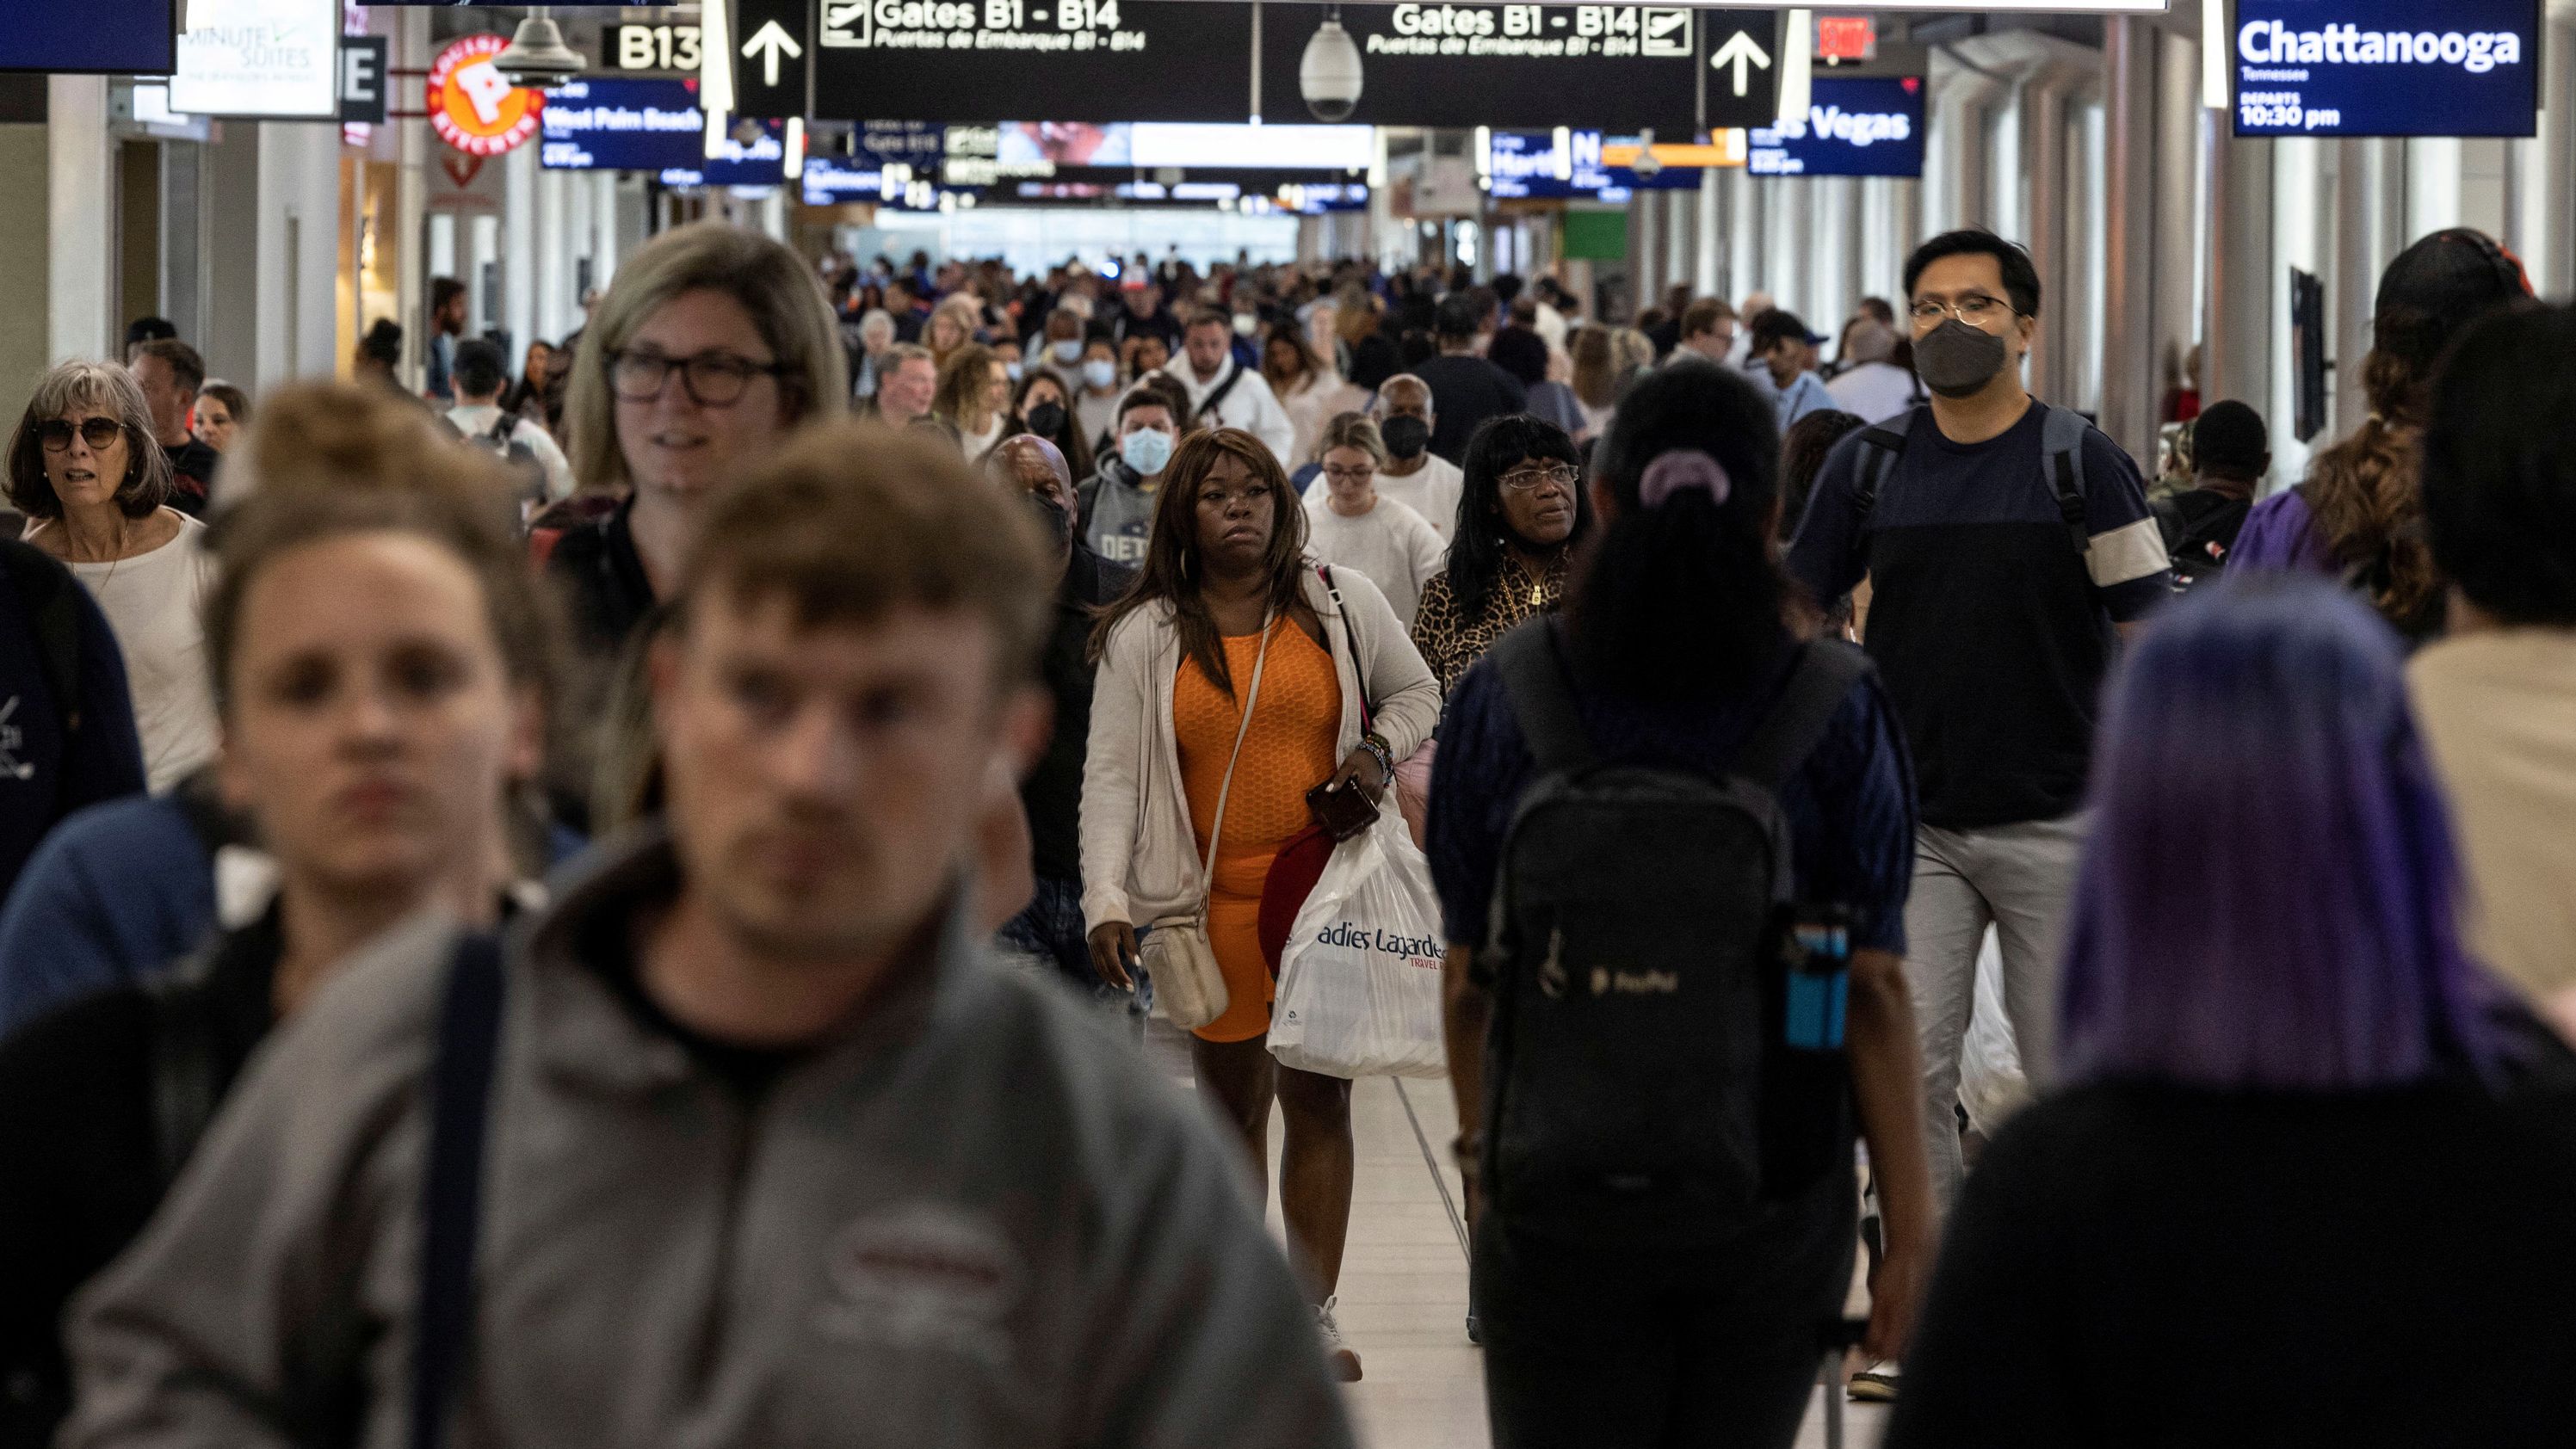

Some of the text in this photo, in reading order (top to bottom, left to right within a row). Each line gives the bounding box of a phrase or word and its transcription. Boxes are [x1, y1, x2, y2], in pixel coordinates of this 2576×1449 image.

[874, 0, 1121, 31] Gates B1 - B14
[1393, 3, 1639, 36] Gates B1 - B14
[619, 25, 701, 71] B13
[874, 28, 946, 48] Puertas
[948, 29, 974, 49] de
[975, 28, 1072, 52] Embarque
[1072, 30, 1096, 51] B1
[1109, 31, 1146, 51] B14
[1367, 34, 1438, 54] Puertas
[1440, 35, 1467, 55] de
[1467, 35, 1565, 58] Embarque
[1565, 36, 1590, 57] B1
[1603, 36, 1638, 57] B14
[2239, 20, 2521, 73] Chattanooga
[239, 46, 312, 68] SUITES
[429, 36, 503, 86] LOUISI
[2239, 66, 2310, 82] Tennessee
[2239, 91, 2301, 105] DEPARTS
[542, 107, 703, 131] West Palm Beach
[1809, 104, 1911, 146] Vegas
[2239, 105, 2340, 131] 10:30 pm
[1101, 533, 1150, 561] DET
[1318, 922, 1372, 950] adies
[1410, 957, 1438, 971] TRAVEL
